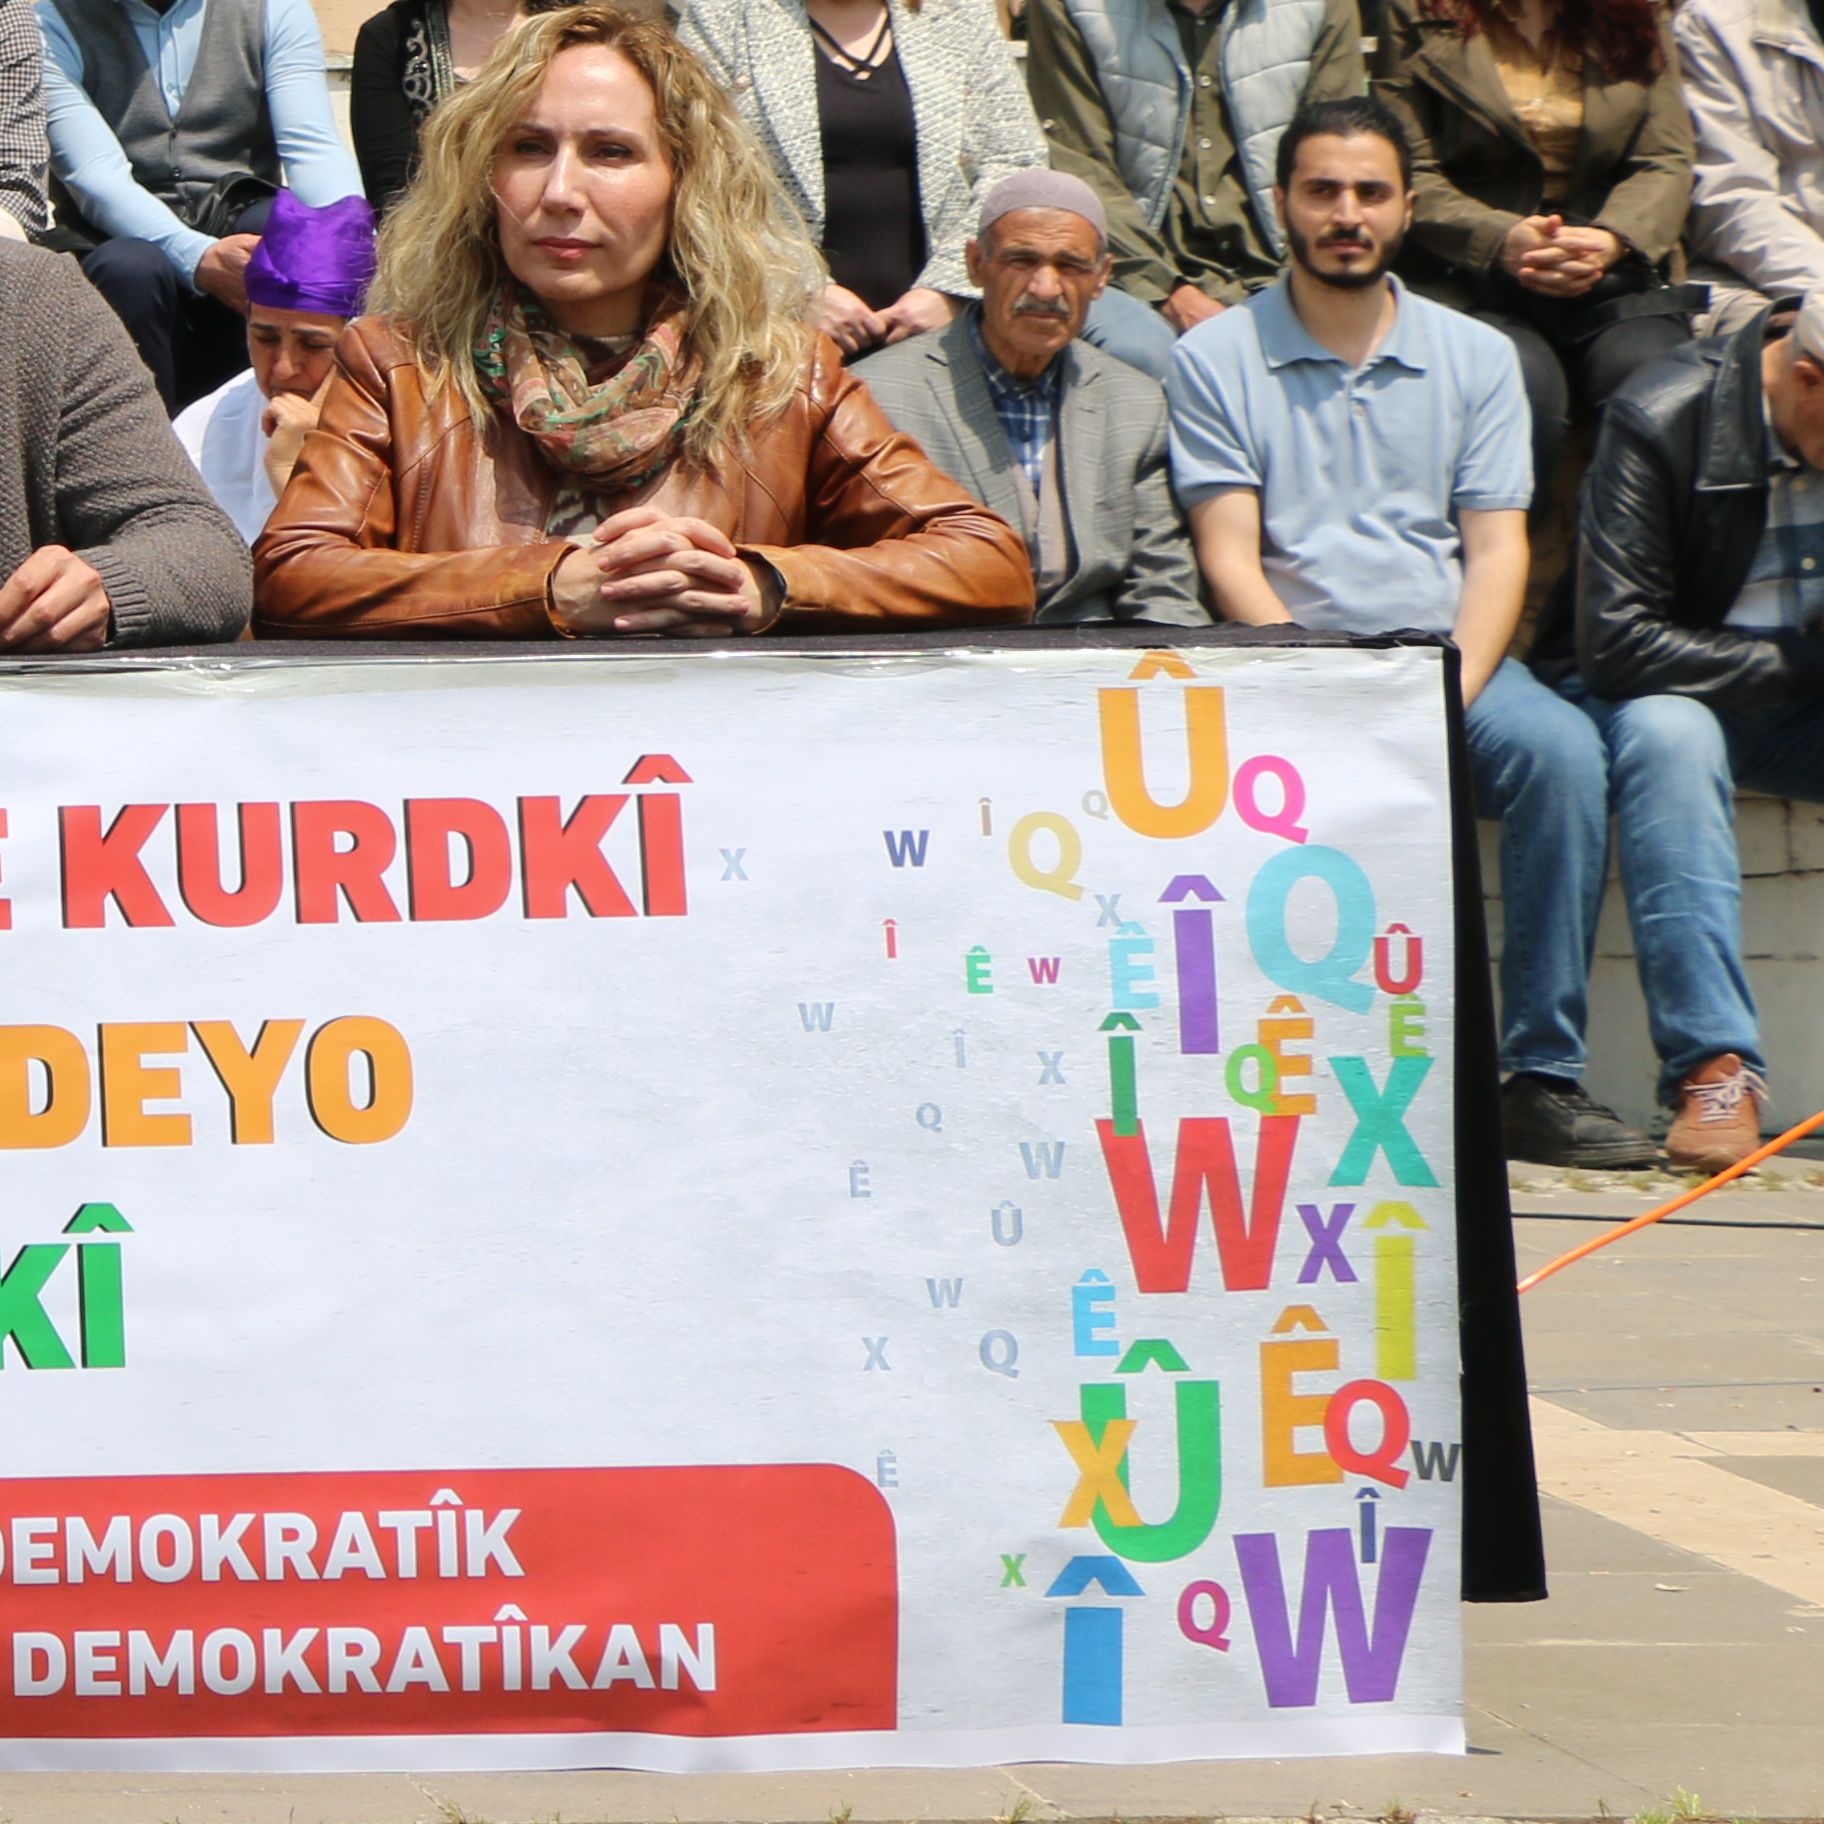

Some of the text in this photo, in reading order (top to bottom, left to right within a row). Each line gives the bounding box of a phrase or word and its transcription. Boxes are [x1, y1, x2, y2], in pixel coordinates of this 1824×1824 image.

[1098, 652, 1226, 838] Û
[1233, 755, 1307, 843] Q
[58, 754, 695, 930] KURDKÎ
[884, 833, 928, 867] W
[1008, 813, 1084, 899] Q
[967, 947, 992, 993] Ê
[1028, 958, 1060, 985] W
[1109, 922, 1158, 1009] Ê
[1159, 875, 1222, 1054] Î
[1246, 846, 1376, 1013] Q
[1374, 924, 1422, 994] Û
[1098, 1012, 1142, 1136] Î
[1225, 1045, 1276, 1114] Q
[1259, 995, 1316, 1116] Ê
[1328, 1058, 1440, 1186] X
[1095, 1116, 1299, 1292] W
[1297, 1205, 1359, 1283] X
[1071, 1270, 1119, 1356] Ê
[1362, 1203, 1428, 1381] Î
[1261, 1305, 1343, 1488] Ê
[1323, 1380, 1409, 1489] Q
[1052, 1420, 1138, 1528] X
[1080, 1339, 1219, 1563] Û
[1411, 1442, 1459, 1481] W
[1000, 1555, 1025, 1586] X
[1177, 1579, 1229, 1651] Q
[1233, 1527, 1432, 1709] W
[12, 1603, 718, 1697] DEMOKRATÎKAN
[1045, 1556, 1143, 1725] Î
